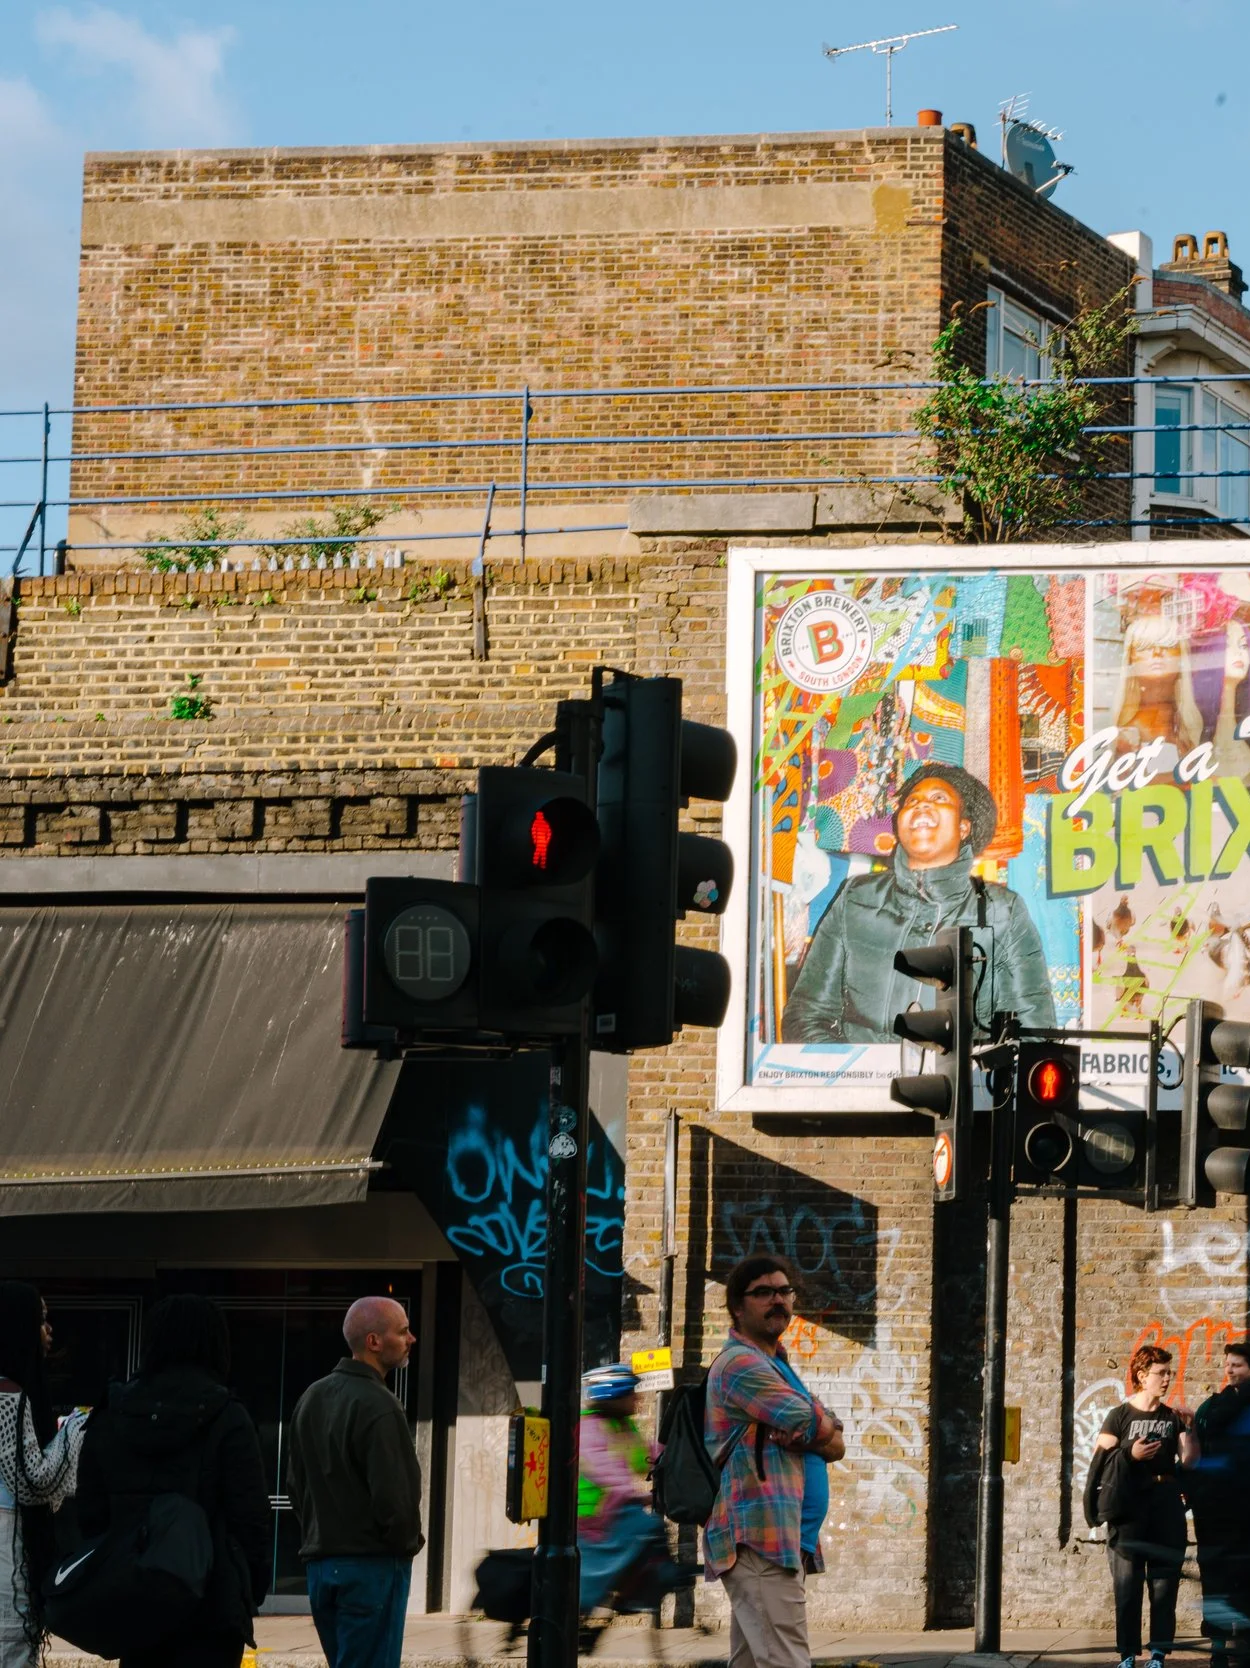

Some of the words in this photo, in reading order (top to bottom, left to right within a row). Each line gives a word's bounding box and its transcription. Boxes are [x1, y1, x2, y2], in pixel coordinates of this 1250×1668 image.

[781, 601, 812, 657] BRIXTON
[815, 595, 868, 633] BREWERY
[1060, 725, 1167, 817] Get
[1178, 741, 1220, 784] a
[758, 1070, 783, 1079] ENJOY
[785, 1070, 819, 1079] BRIXTON
[820, 1070, 874, 1080] RESPONSIBLY
